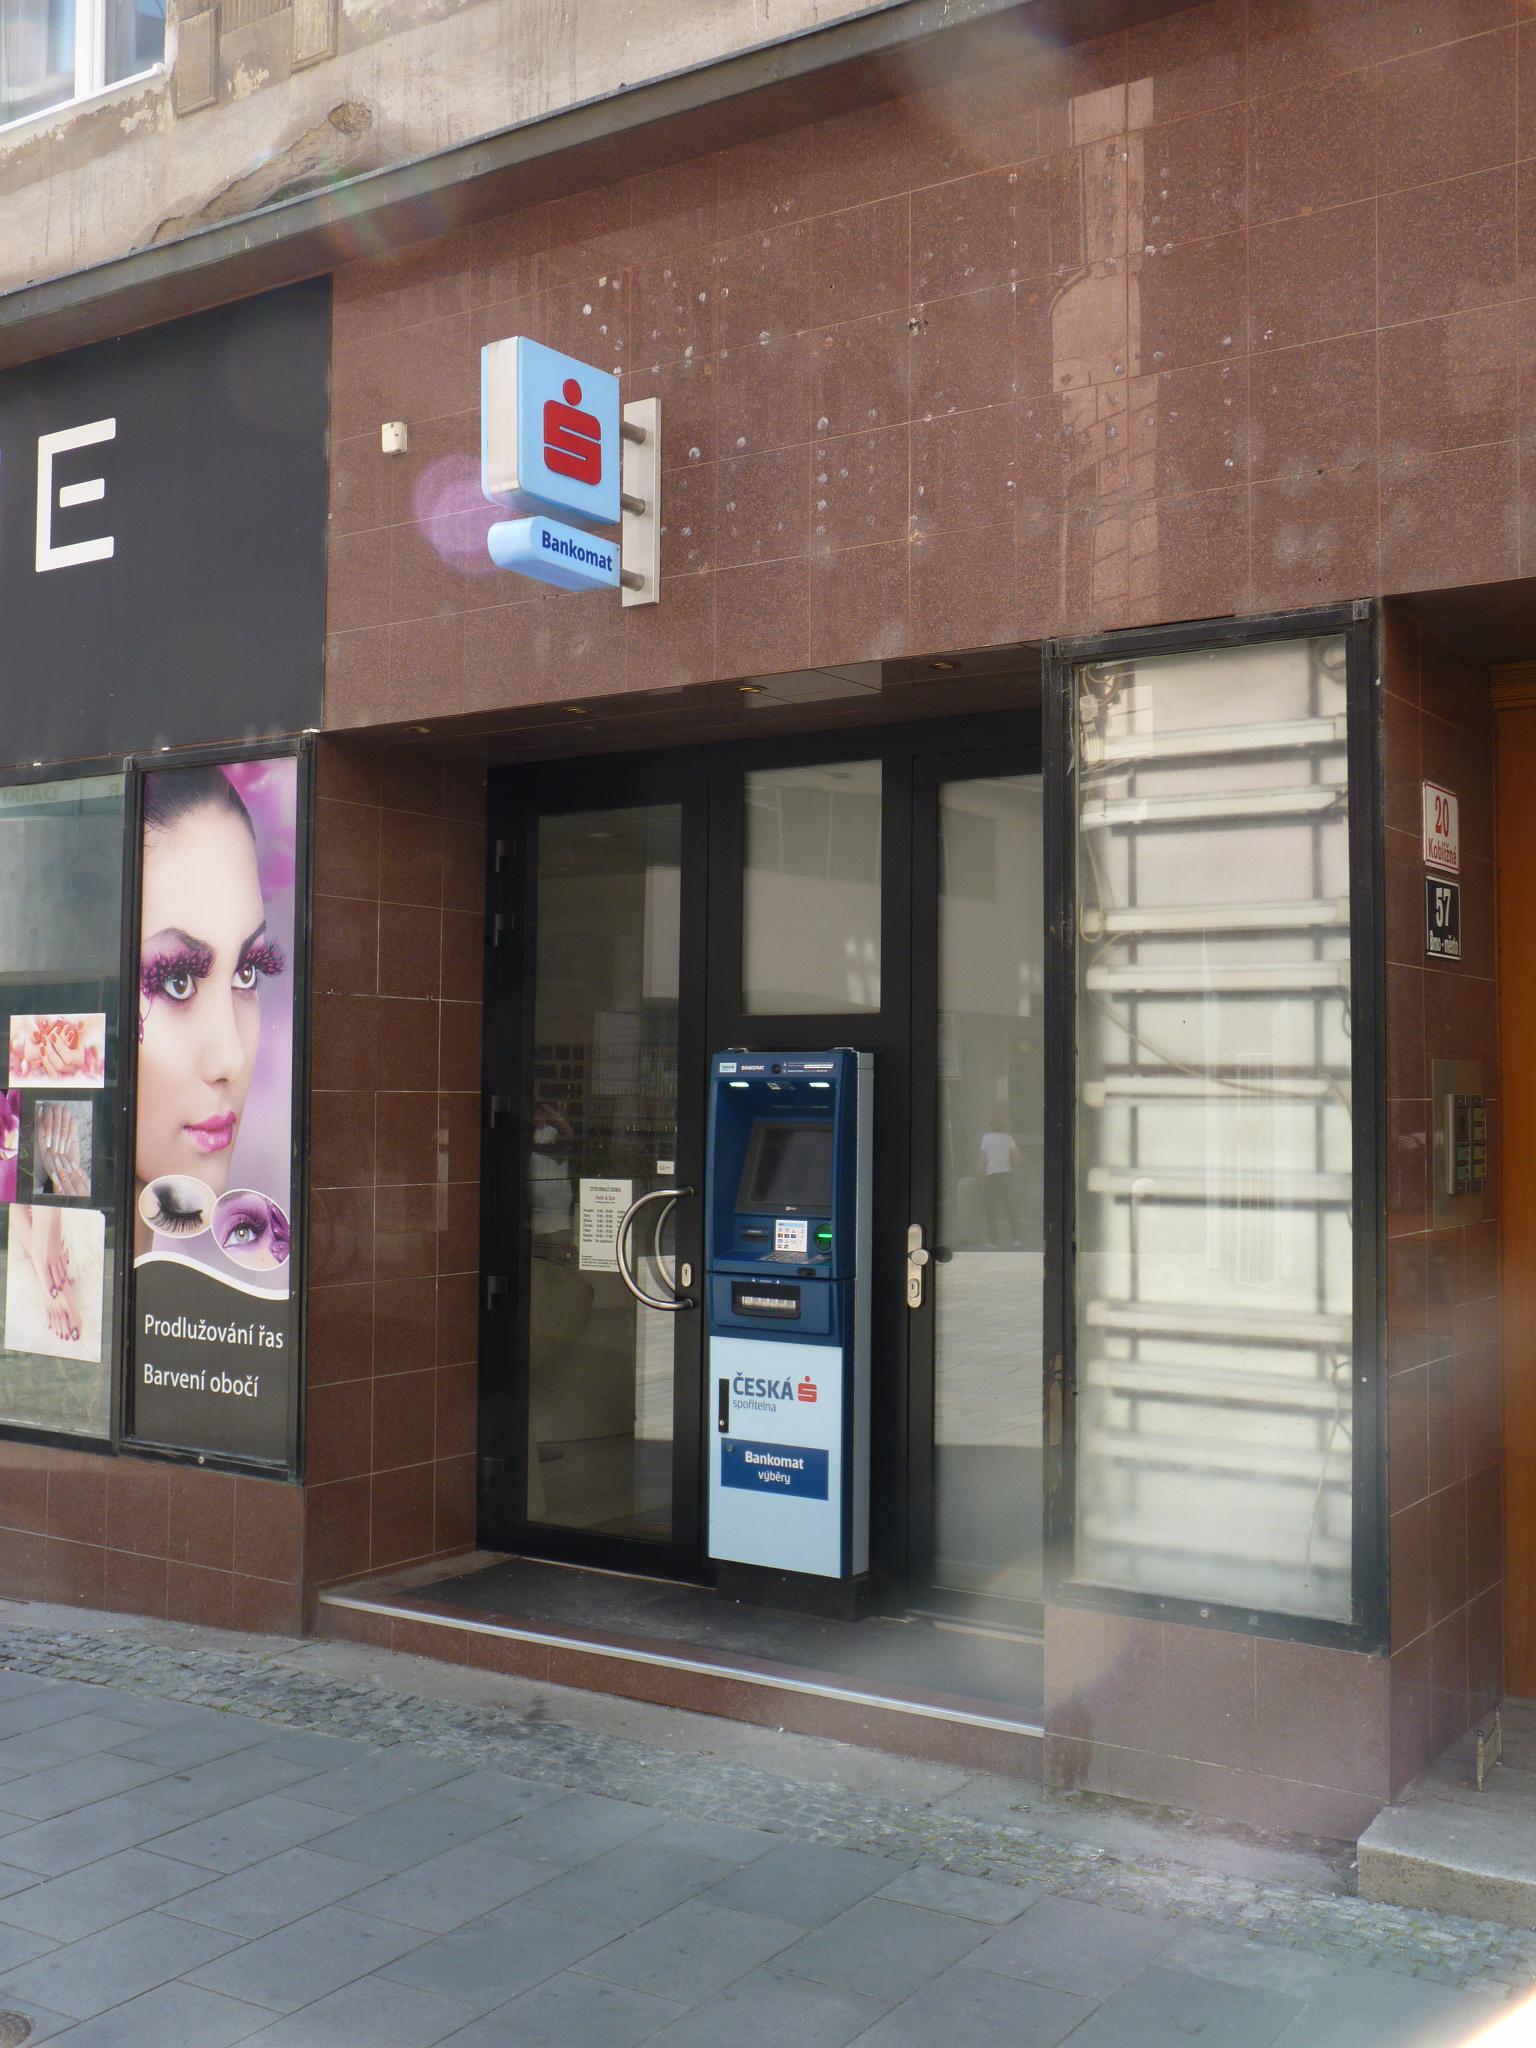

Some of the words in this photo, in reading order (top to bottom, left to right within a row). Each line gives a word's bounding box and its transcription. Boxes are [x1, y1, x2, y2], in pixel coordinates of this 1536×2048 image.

[35, 417, 116, 573] E
[542, 530, 613, 572] Bankomat
[1435, 795, 1449, 837] 20
[1435, 888, 1451, 928] 57
[144, 1314, 254, 1345] Prodlužování
[258, 1324, 284, 1349] řas
[144, 1363, 206, 1391] Barvení
[210, 1371, 259, 1398] obočí
[733, 1371, 794, 1401] ČESKÁ
[732, 1399, 777, 1412] spořitelna
[744, 1450, 804, 1470] Bankomat
[758, 1470, 791, 1485] výběry
